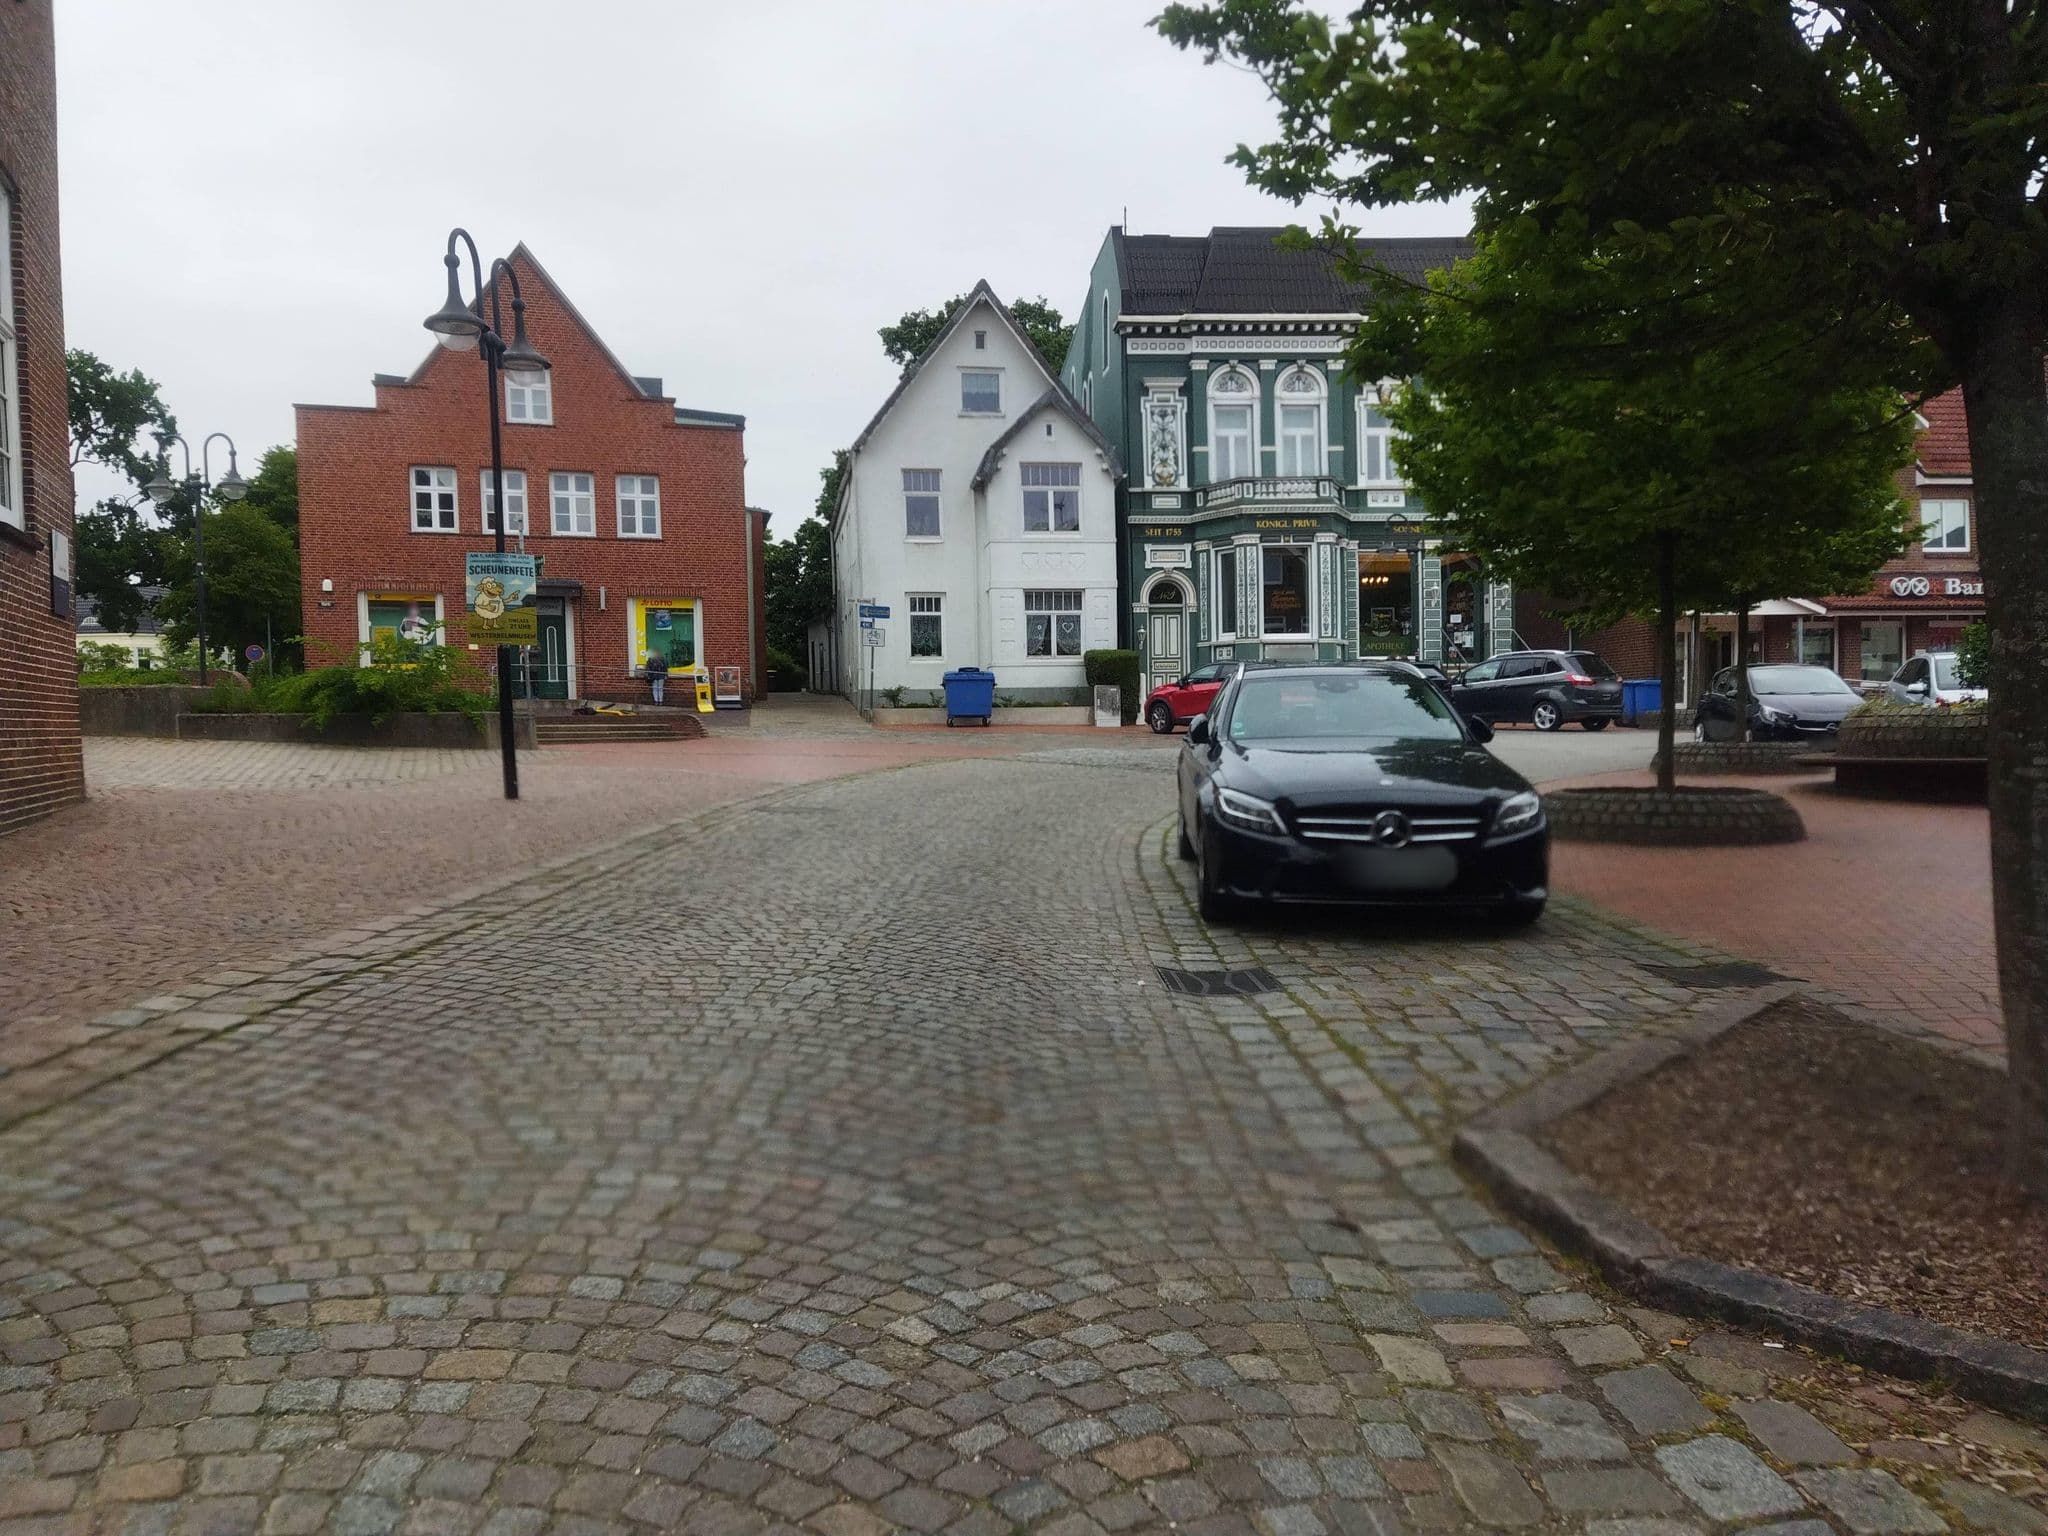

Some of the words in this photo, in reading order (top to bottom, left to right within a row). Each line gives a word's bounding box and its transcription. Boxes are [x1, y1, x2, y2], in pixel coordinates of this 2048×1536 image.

[1145, 527, 1162, 537] SEIT
[468, 564, 535, 577] SCHEUNENFETE
[1365, 640, 1406, 650] APOTHEKE
